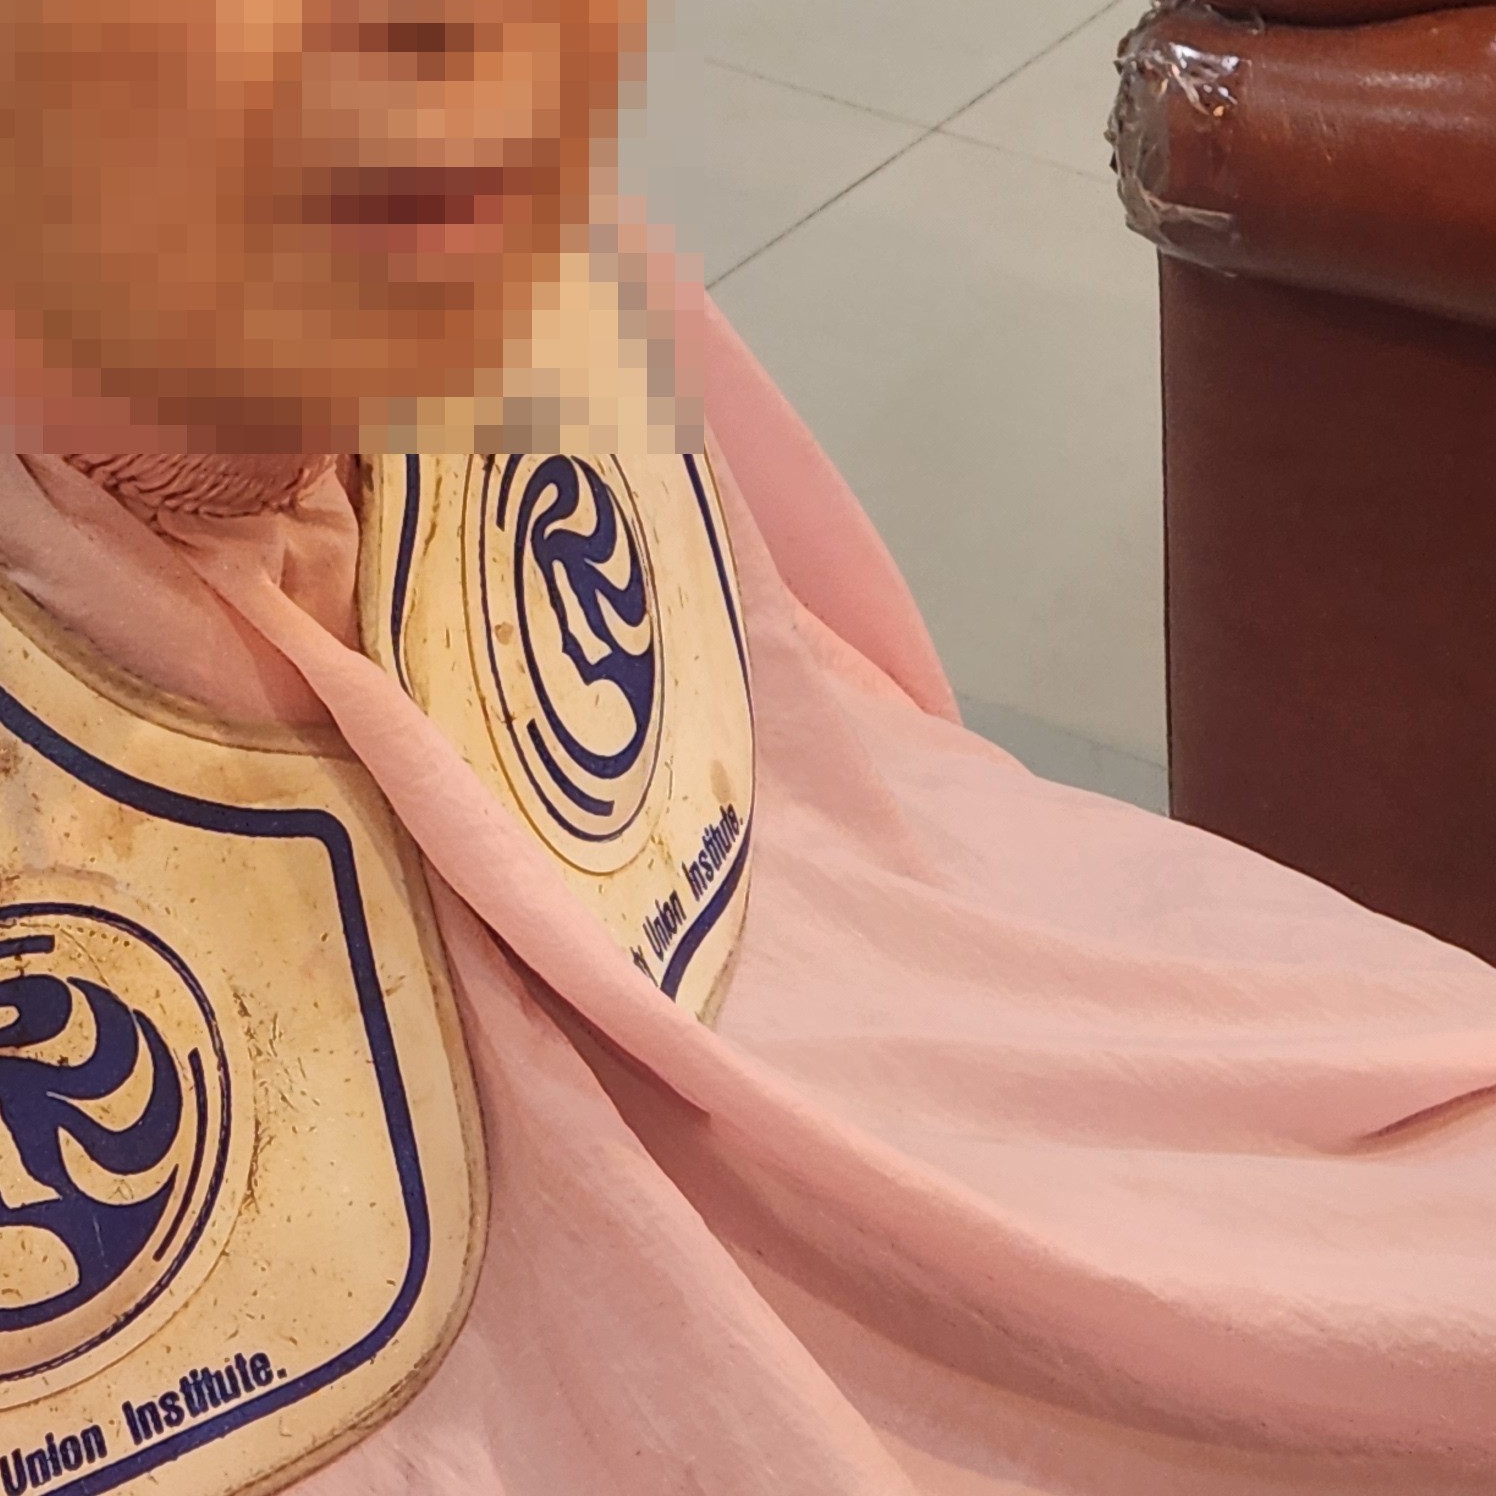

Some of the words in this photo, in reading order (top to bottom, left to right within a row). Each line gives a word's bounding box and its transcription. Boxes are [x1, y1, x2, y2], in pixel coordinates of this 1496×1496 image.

[642, 890, 687, 962] Union
[681, 803, 744, 902] Institute.
[121, 1352, 287, 1445] Institute.
